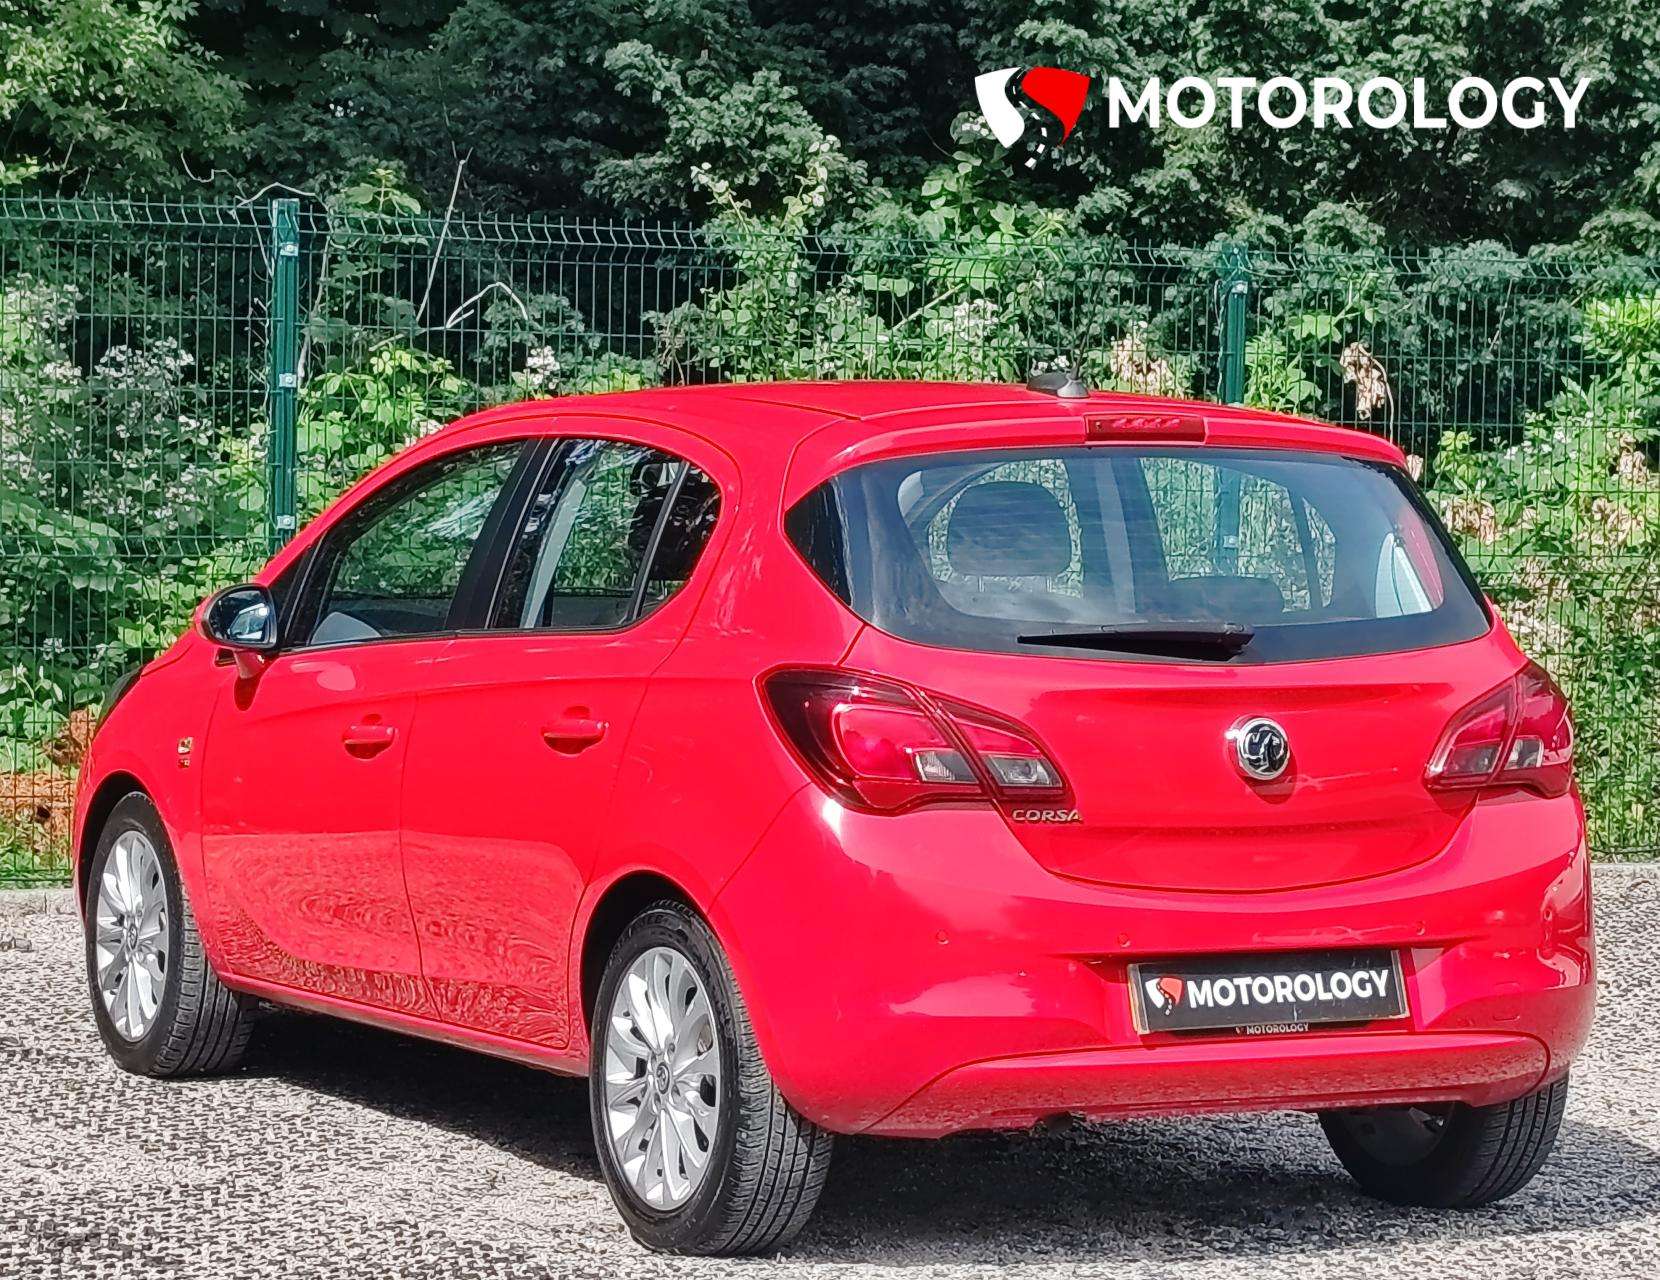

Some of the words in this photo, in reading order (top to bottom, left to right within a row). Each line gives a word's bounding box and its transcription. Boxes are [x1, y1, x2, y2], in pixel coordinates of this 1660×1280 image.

[1012, 809, 1083, 822] CORSA
[1187, 969, 1389, 1009] MOTOROLOGY
[1246, 1022, 1309, 1035] MOTOROLOGY
